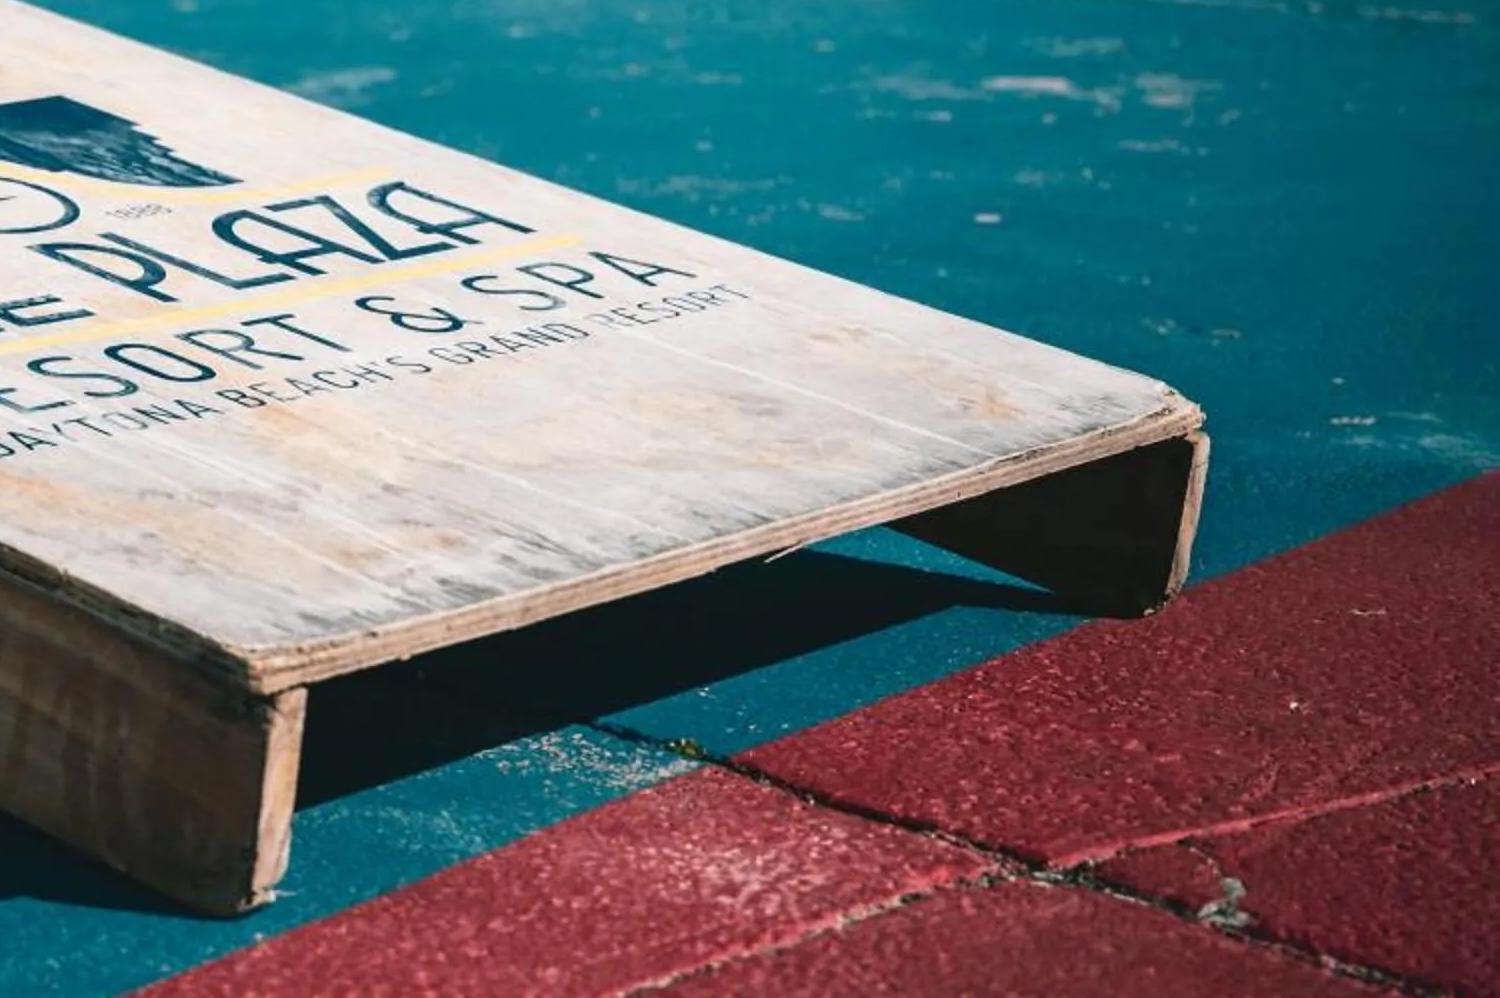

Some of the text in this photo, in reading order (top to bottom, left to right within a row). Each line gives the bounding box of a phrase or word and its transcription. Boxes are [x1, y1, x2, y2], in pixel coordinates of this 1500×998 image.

[25, 181, 538, 303] PLAZA
[355, 294, 486, 334] &
[460, 251, 698, 312] SPA
[215, 355, 432, 409] BEACH'S
[428, 322, 591, 364] GRAND
[582, 283, 749, 330] RESORT
